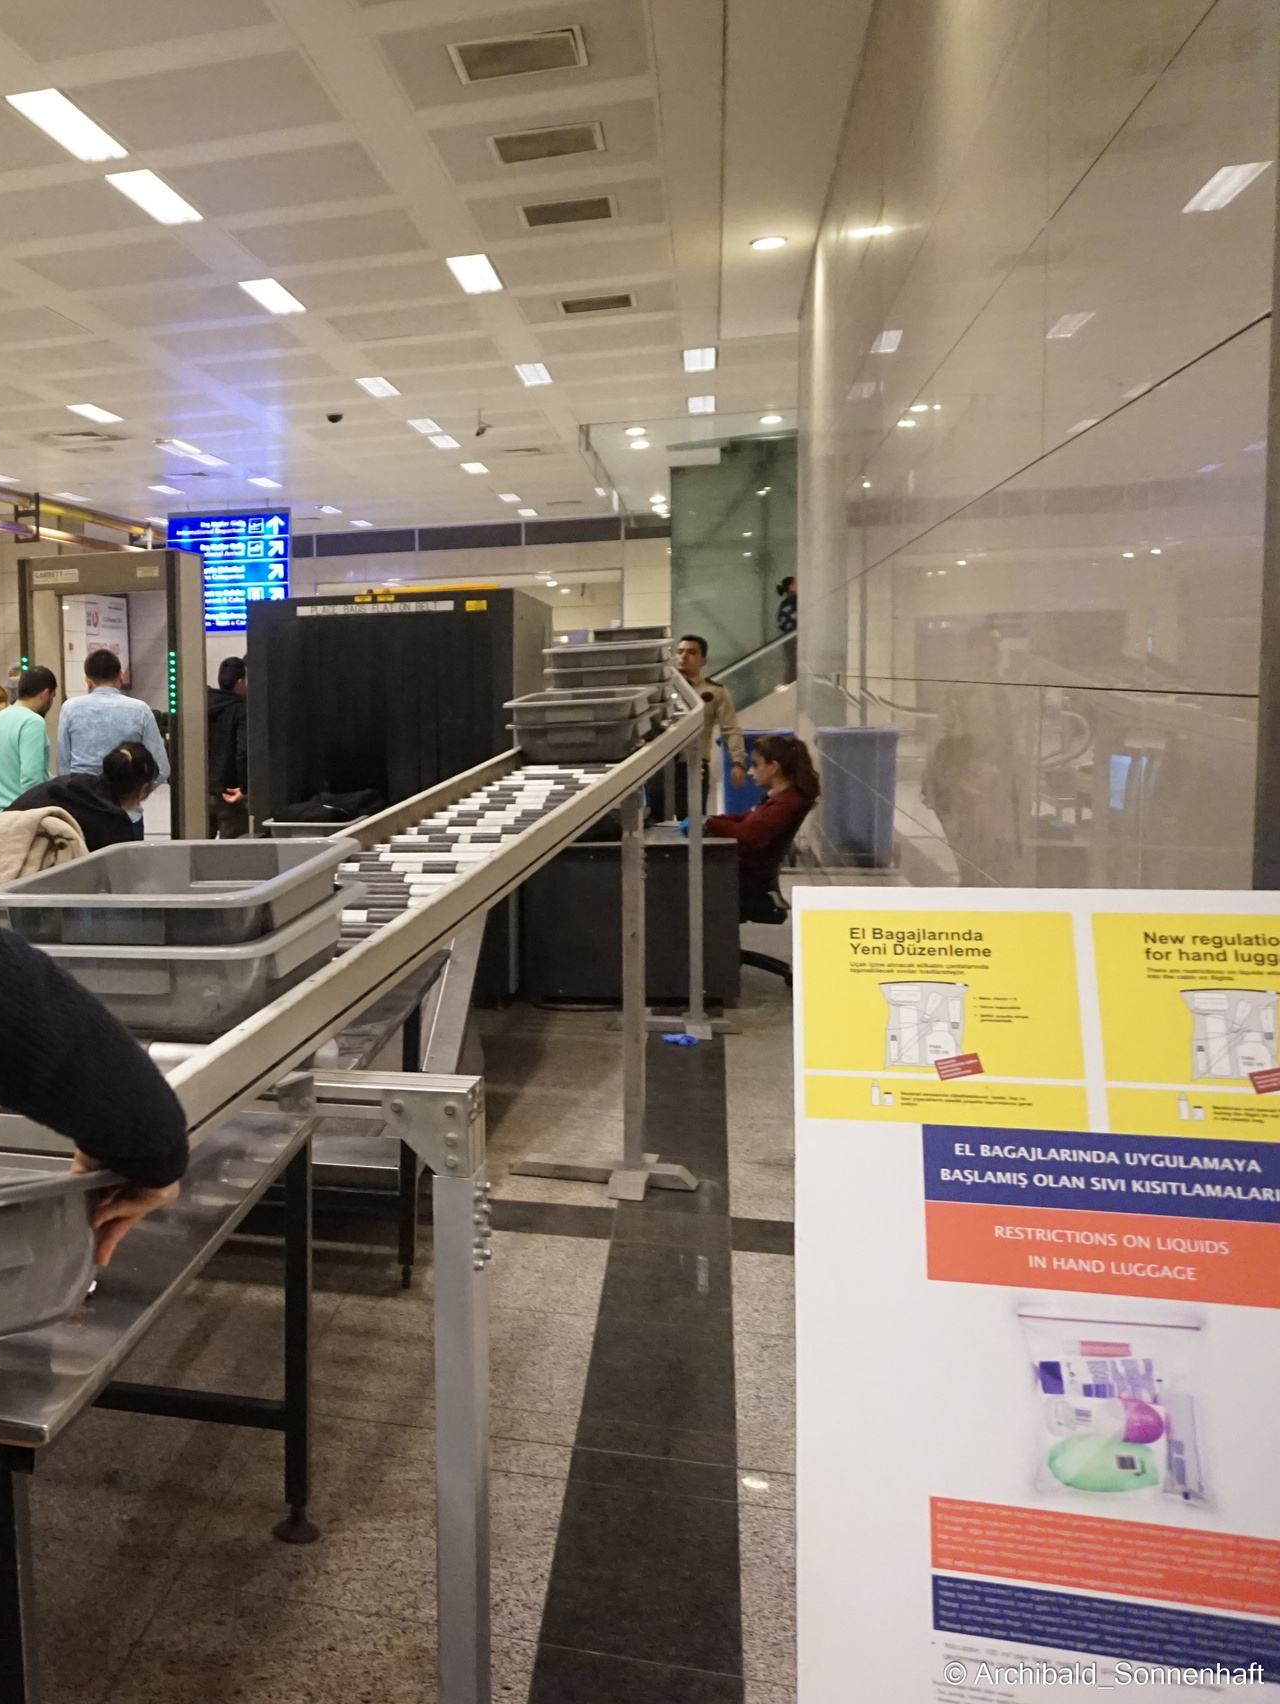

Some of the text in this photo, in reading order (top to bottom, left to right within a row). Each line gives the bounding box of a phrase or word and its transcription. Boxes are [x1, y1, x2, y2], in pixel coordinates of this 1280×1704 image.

[310, 601, 438, 615] PLACE BAGS FLAT ON BELT
[850, 928, 983, 943] El Bagajlarında
[1144, 932, 1184, 945] New
[850, 943, 992, 957] Yeni Düzenleme
[1146, 948, 1280, 966] for hand lugg
[954, 1143, 1262, 1173] EL BAGAJLARINDA UYGULAMAYA
[940, 1168, 1029, 1189] BAŞLAMIŞ
[1033, 1174, 1085, 1189] OLAN
[1090, 1177, 1126, 1192] SIVI
[994, 1225, 1230, 1255] RESTRICTIONS ON LIQUIDS
[1028, 1255, 1198, 1281] IN HAND LUGGAGE
